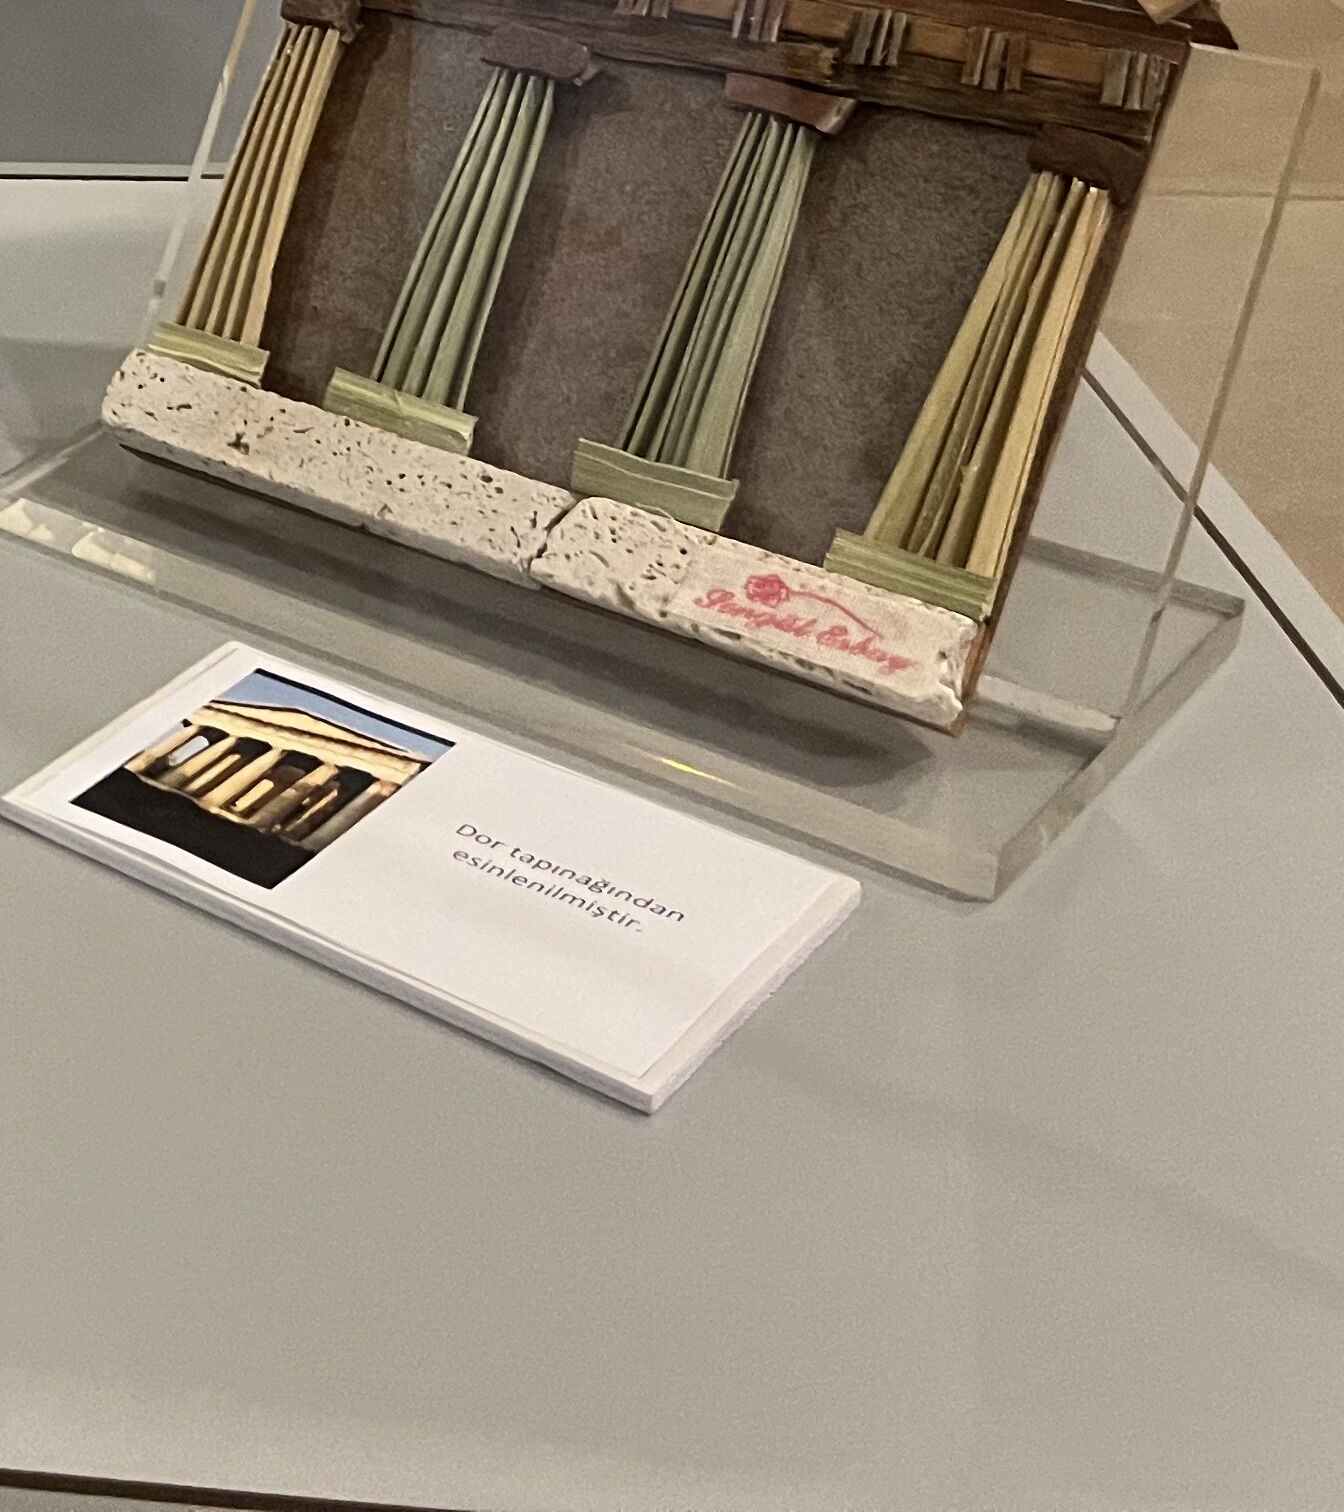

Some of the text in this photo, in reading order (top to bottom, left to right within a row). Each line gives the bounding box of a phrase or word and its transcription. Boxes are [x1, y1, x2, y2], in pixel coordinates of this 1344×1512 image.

[452, 848, 643, 934] esinlenilmiştir.
[455, 823, 686, 923] Dor tapınağından
